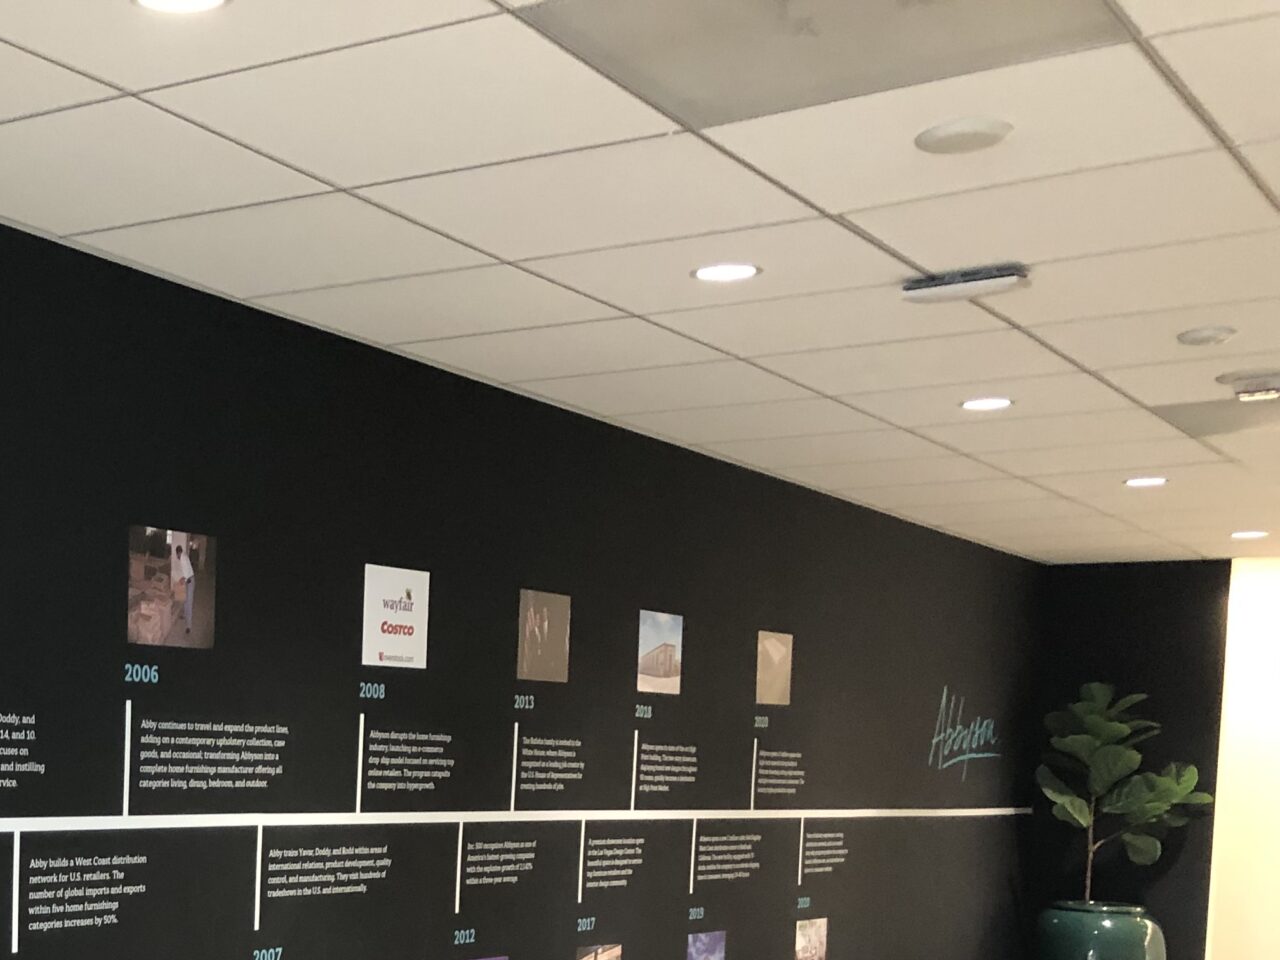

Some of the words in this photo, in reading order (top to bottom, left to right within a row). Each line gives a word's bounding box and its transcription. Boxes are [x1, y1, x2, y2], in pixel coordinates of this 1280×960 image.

[383, 597, 414, 614] wayfair
[124, 664, 159, 683] 2006
[360, 682, 385, 699] 2008
[514, 695, 534, 709] 2013
[22, 714, 35, 724] and
[928, 685, 998, 782] Abbyson
[29, 858, 48, 870] Abby
[49, 857, 68, 867] builds
[75, 857, 92, 866] West
[93, 856, 110, 865] Coast
[112, 855, 146, 864] distribution
[577, 917, 596, 931] 2017
[454, 929, 475, 945] 2012
